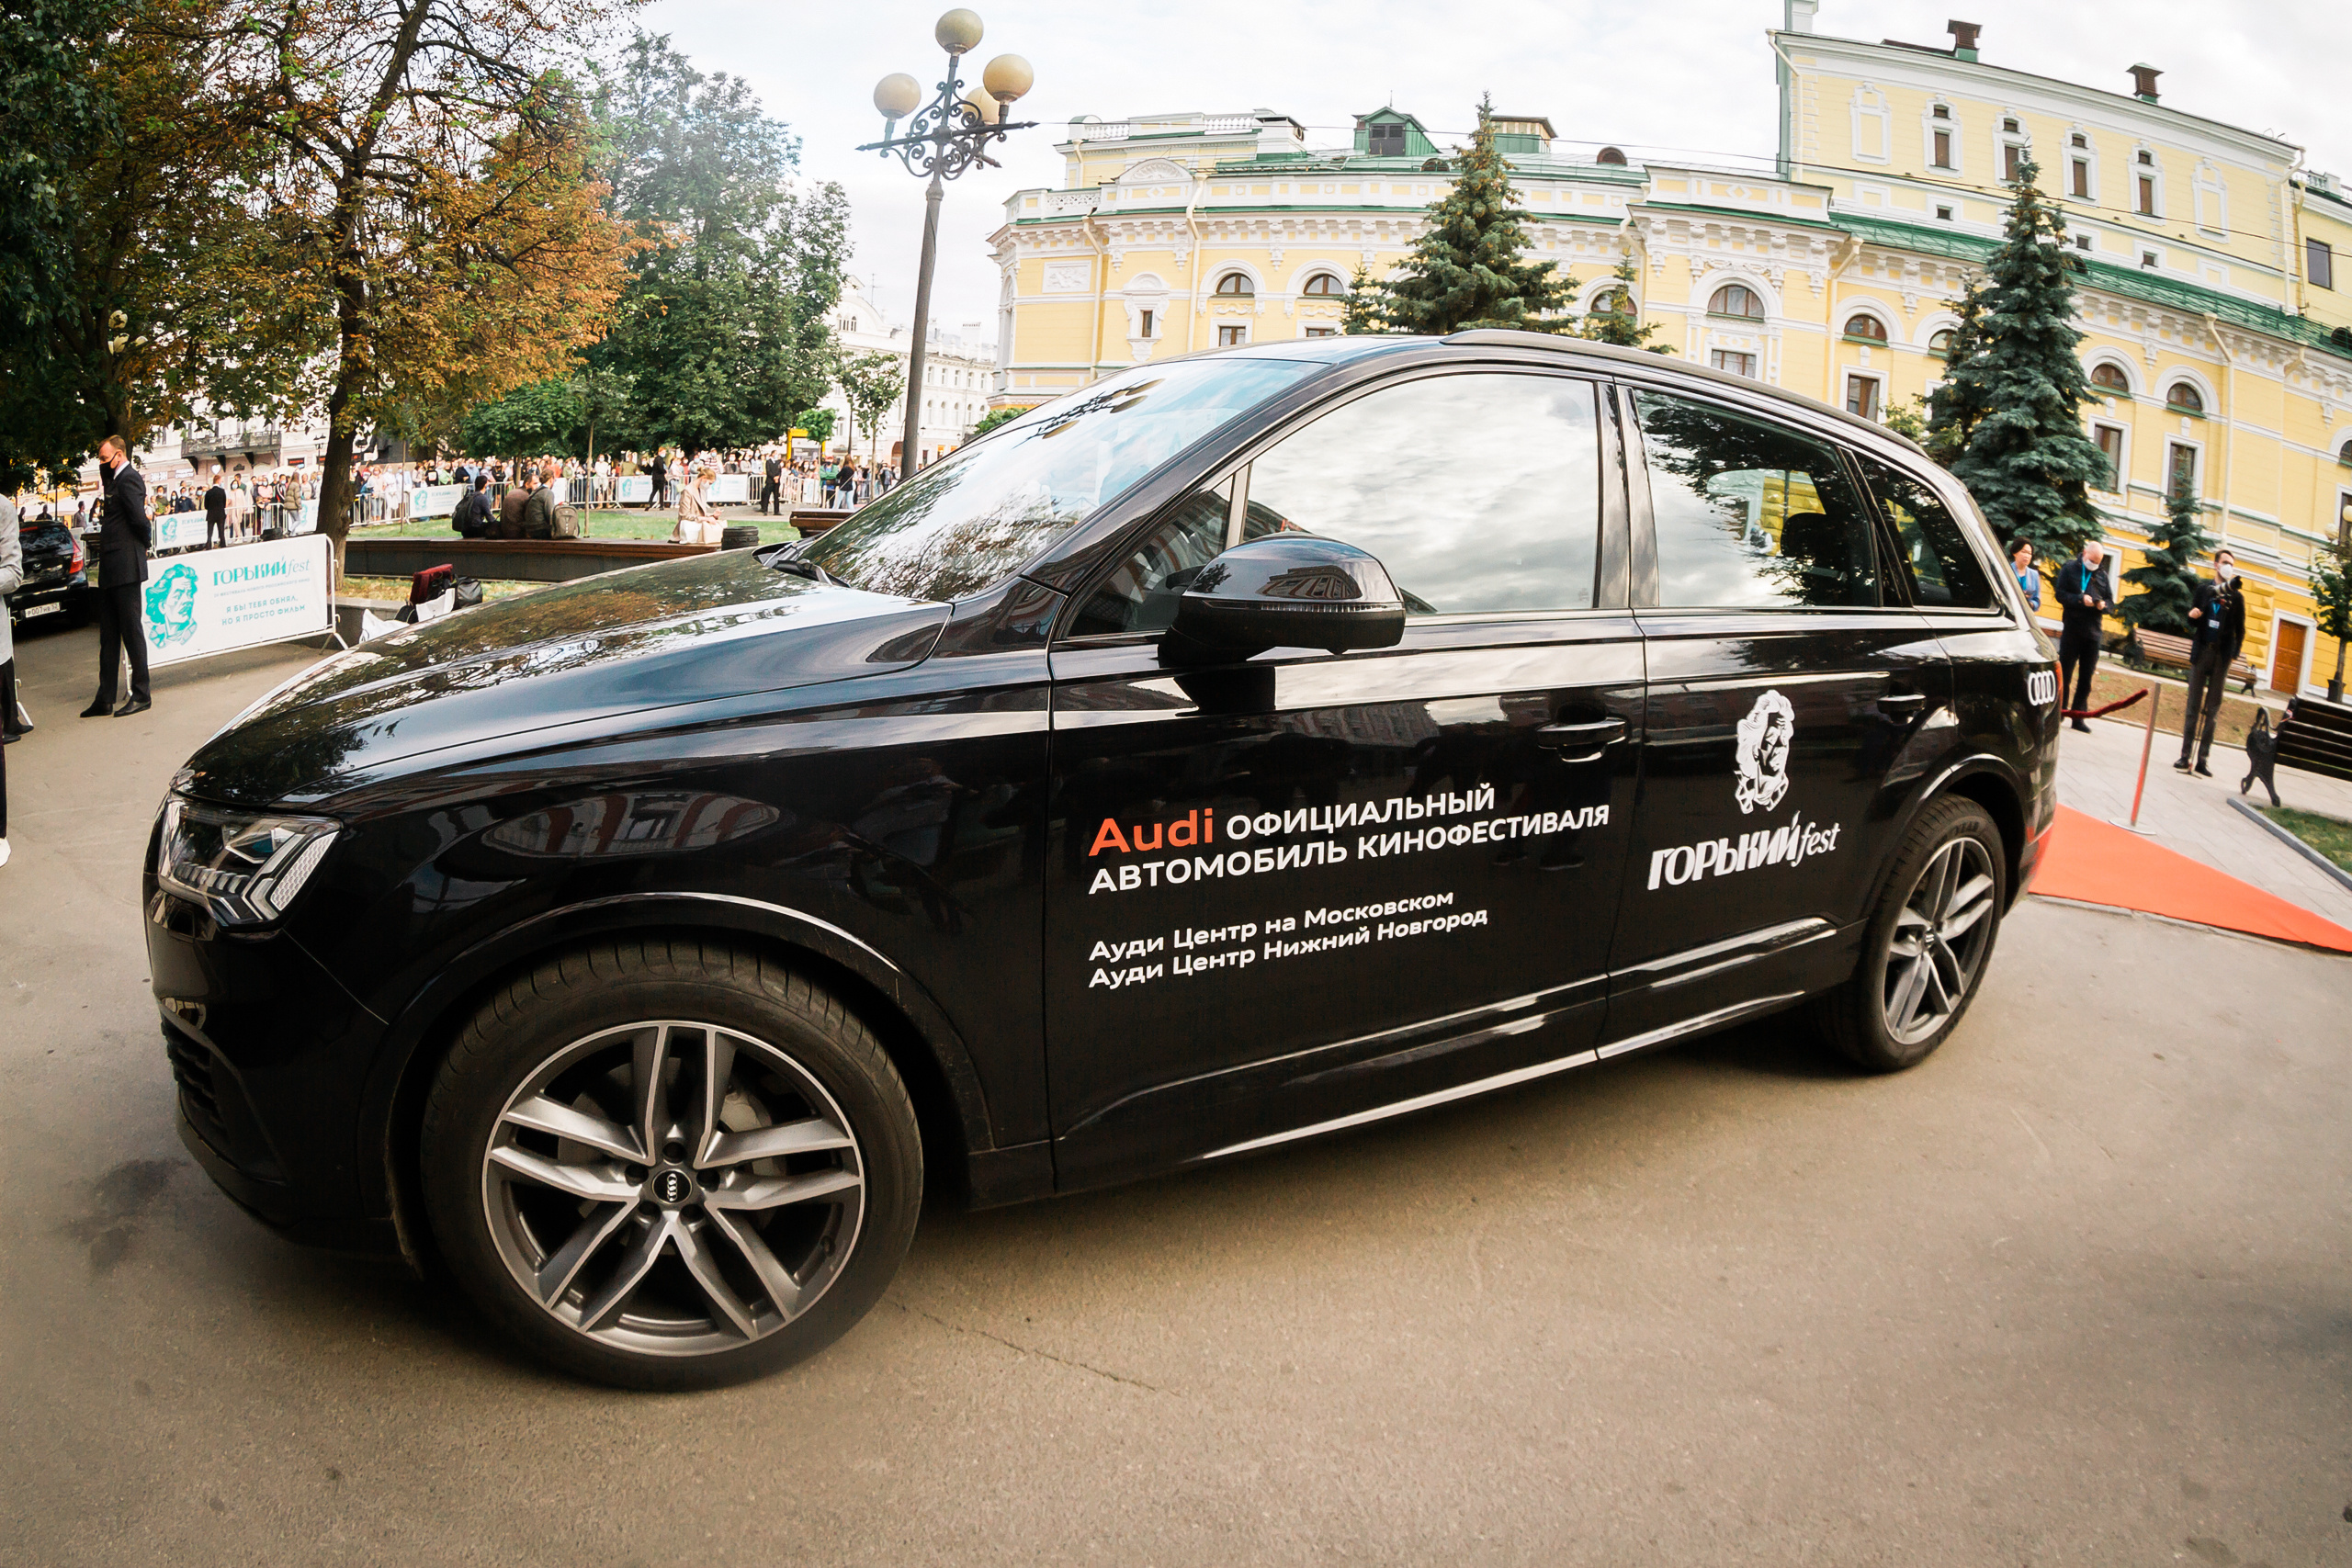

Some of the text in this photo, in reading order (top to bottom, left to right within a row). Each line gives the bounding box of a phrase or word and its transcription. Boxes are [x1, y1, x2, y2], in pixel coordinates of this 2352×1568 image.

[221, 617, 233, 626] НО
[243, 609, 276, 622] ПРОСТО
[277, 604, 306, 615] ФИЛЬМ
[233, 604, 246, 612] БЫ
[248, 599, 267, 610] ТЕБЯ
[1088, 782, 1495, 857] Audi ОФИЦИАЛЬНЫЙ
[1088, 804, 1610, 895] АВТОМОБИЛЬ КИНОФЕСТИВАЛЯ
[1088, 892, 1453, 964] Ауди Центр на Московском
[1088, 909, 1488, 990] Ауди Центр Нижний Новгород
